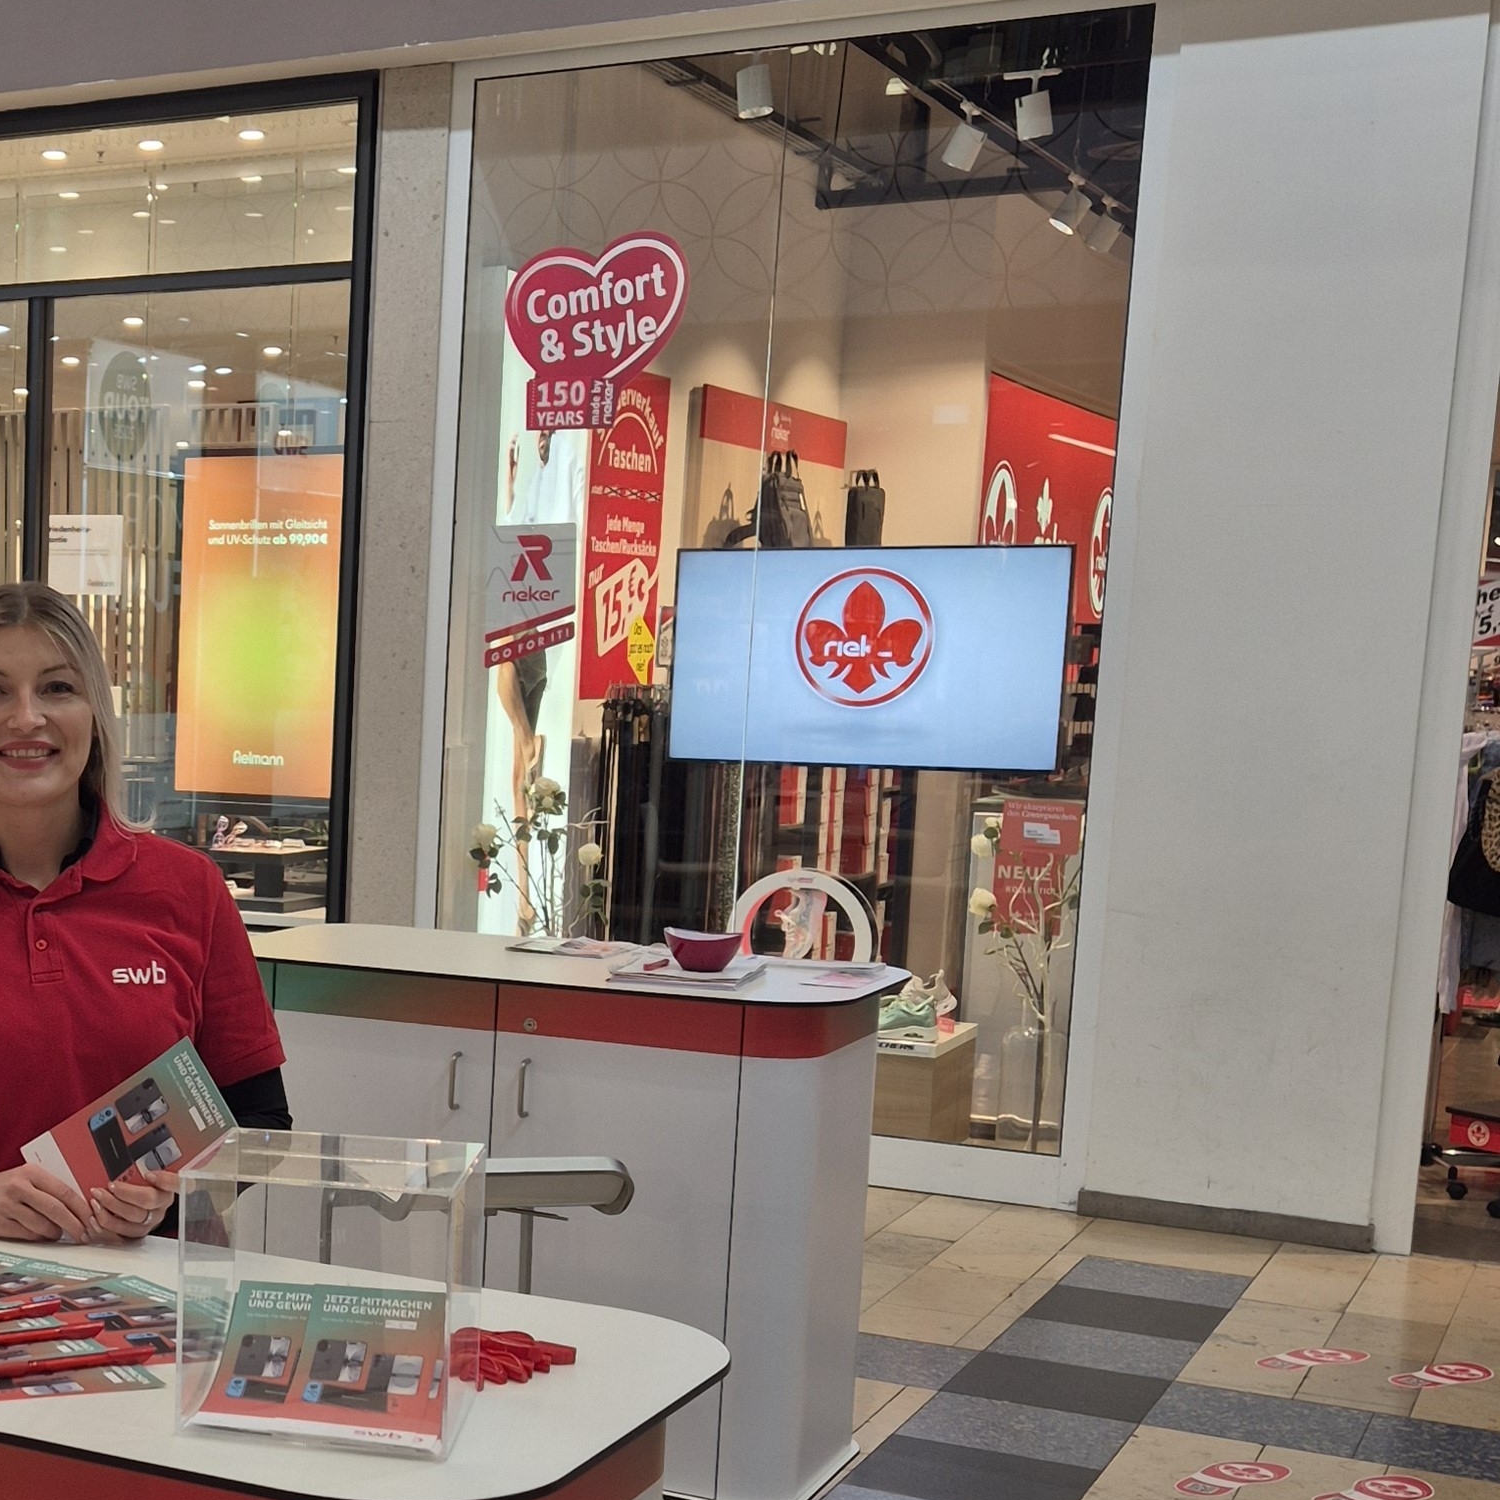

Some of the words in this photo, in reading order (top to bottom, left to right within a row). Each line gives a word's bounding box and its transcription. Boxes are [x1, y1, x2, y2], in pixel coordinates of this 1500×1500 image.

[526, 263, 667, 324] Comfort
[540, 328, 566, 363] &
[572, 308, 658, 359] Style
[537, 380, 586, 408] 150
[591, 380, 603, 394] by
[537, 410, 585, 427] YEARS
[591, 395, 600, 425] made
[607, 442, 652, 473] Taschen
[208, 519, 268, 530] Sonnenbrillen
[269, 519, 284, 530] mit
[285, 519, 328, 530] Gleitsicht
[605, 514, 622, 534] jede
[622, 517, 645, 537] Menge
[208, 534, 225, 545] und
[226, 534, 271, 545] UV-Schutz
[272, 533, 287, 545] ab
[588, 563, 604, 590] nur
[502, 586, 560, 602] rieker
[491, 648, 513, 662] GO
[517, 637, 545, 655] FOR
[111, 960, 167, 985] swb
[173, 1056, 188, 1076] UND
[184, 1075, 216, 1127] GEWINNEN!
[179, 1051, 199, 1076] JETZT
[193, 1074, 227, 1130] MITMACHEN
[248, 1299, 274, 1309] UND
[250, 1289, 284, 1301] JETZT
[324, 1294, 358, 1305] JETZT
[360, 1297, 433, 1311] MITMACHEN
[323, 1303, 349, 1314] UND
[351, 1305, 420, 1320] GEWINNEN!
